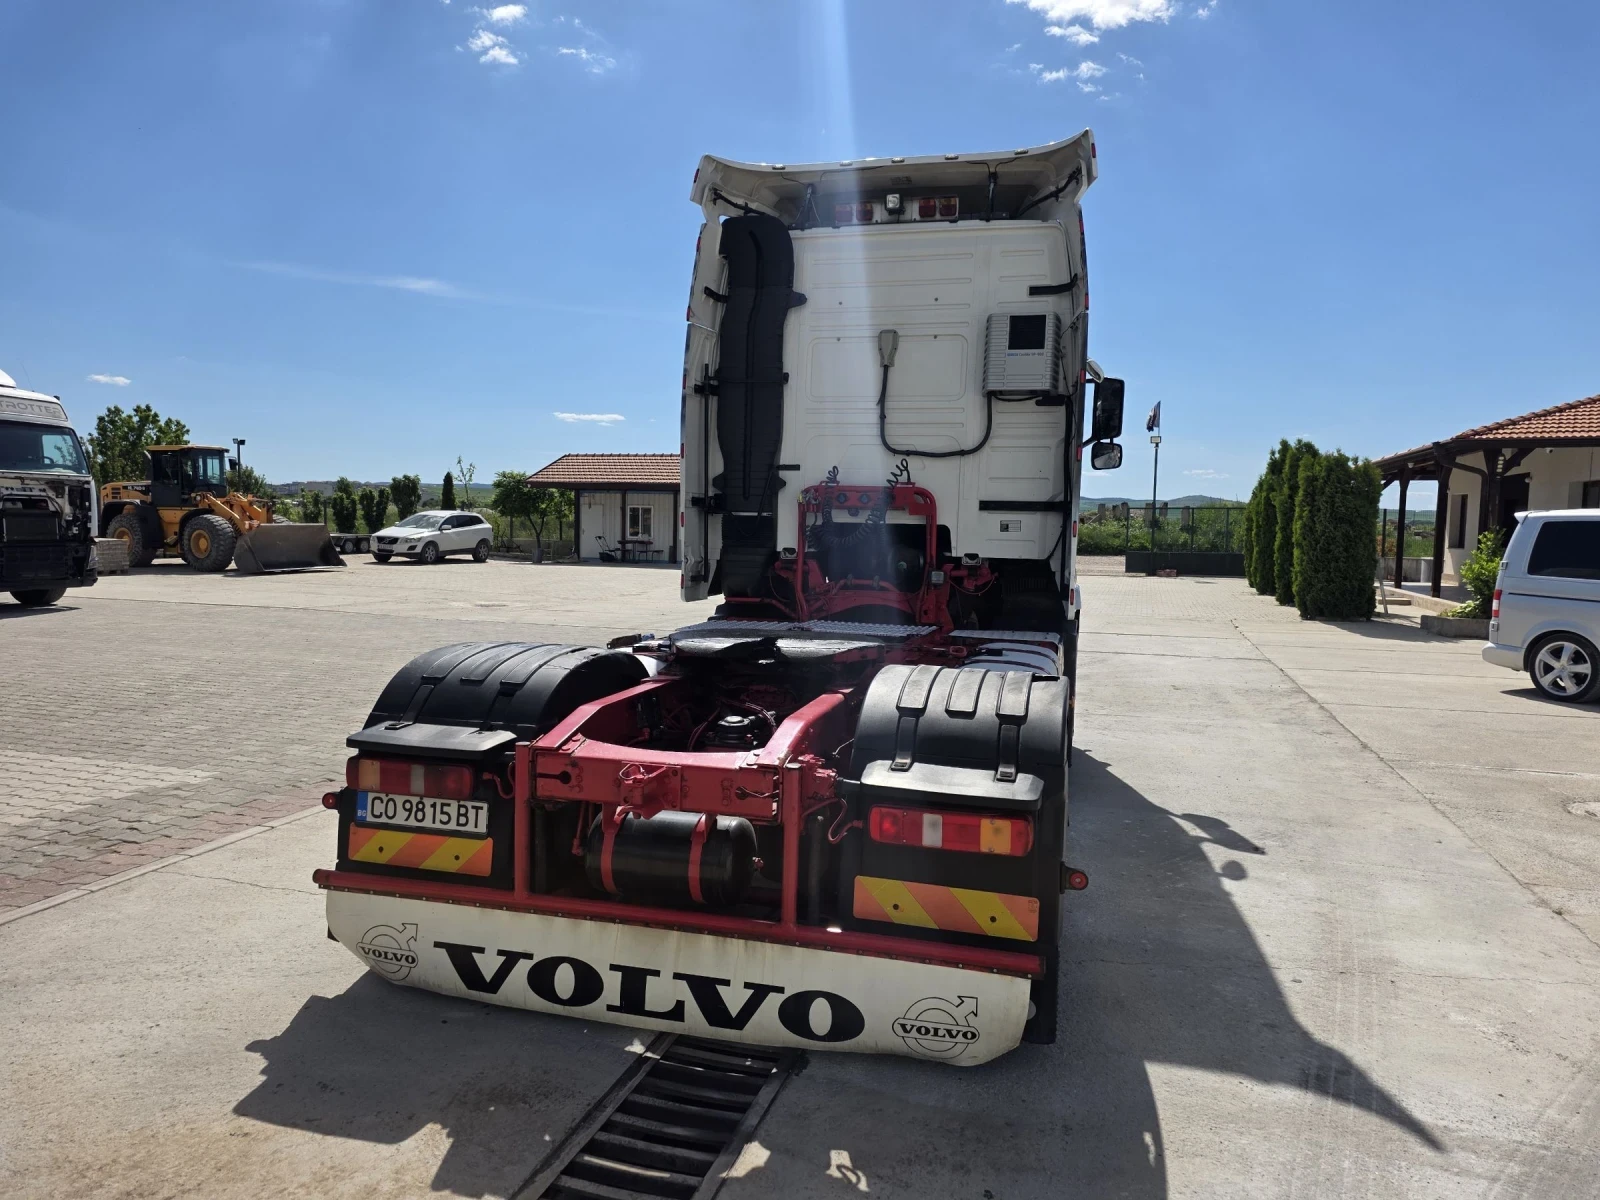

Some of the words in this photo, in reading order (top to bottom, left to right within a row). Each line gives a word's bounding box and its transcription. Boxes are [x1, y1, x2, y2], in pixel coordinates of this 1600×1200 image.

[357, 809, 367, 817] BG
[358, 945, 417, 965] VOLVO
[433, 940, 866, 1043] VOLVO
[897, 1022, 977, 1041] VOLVO
